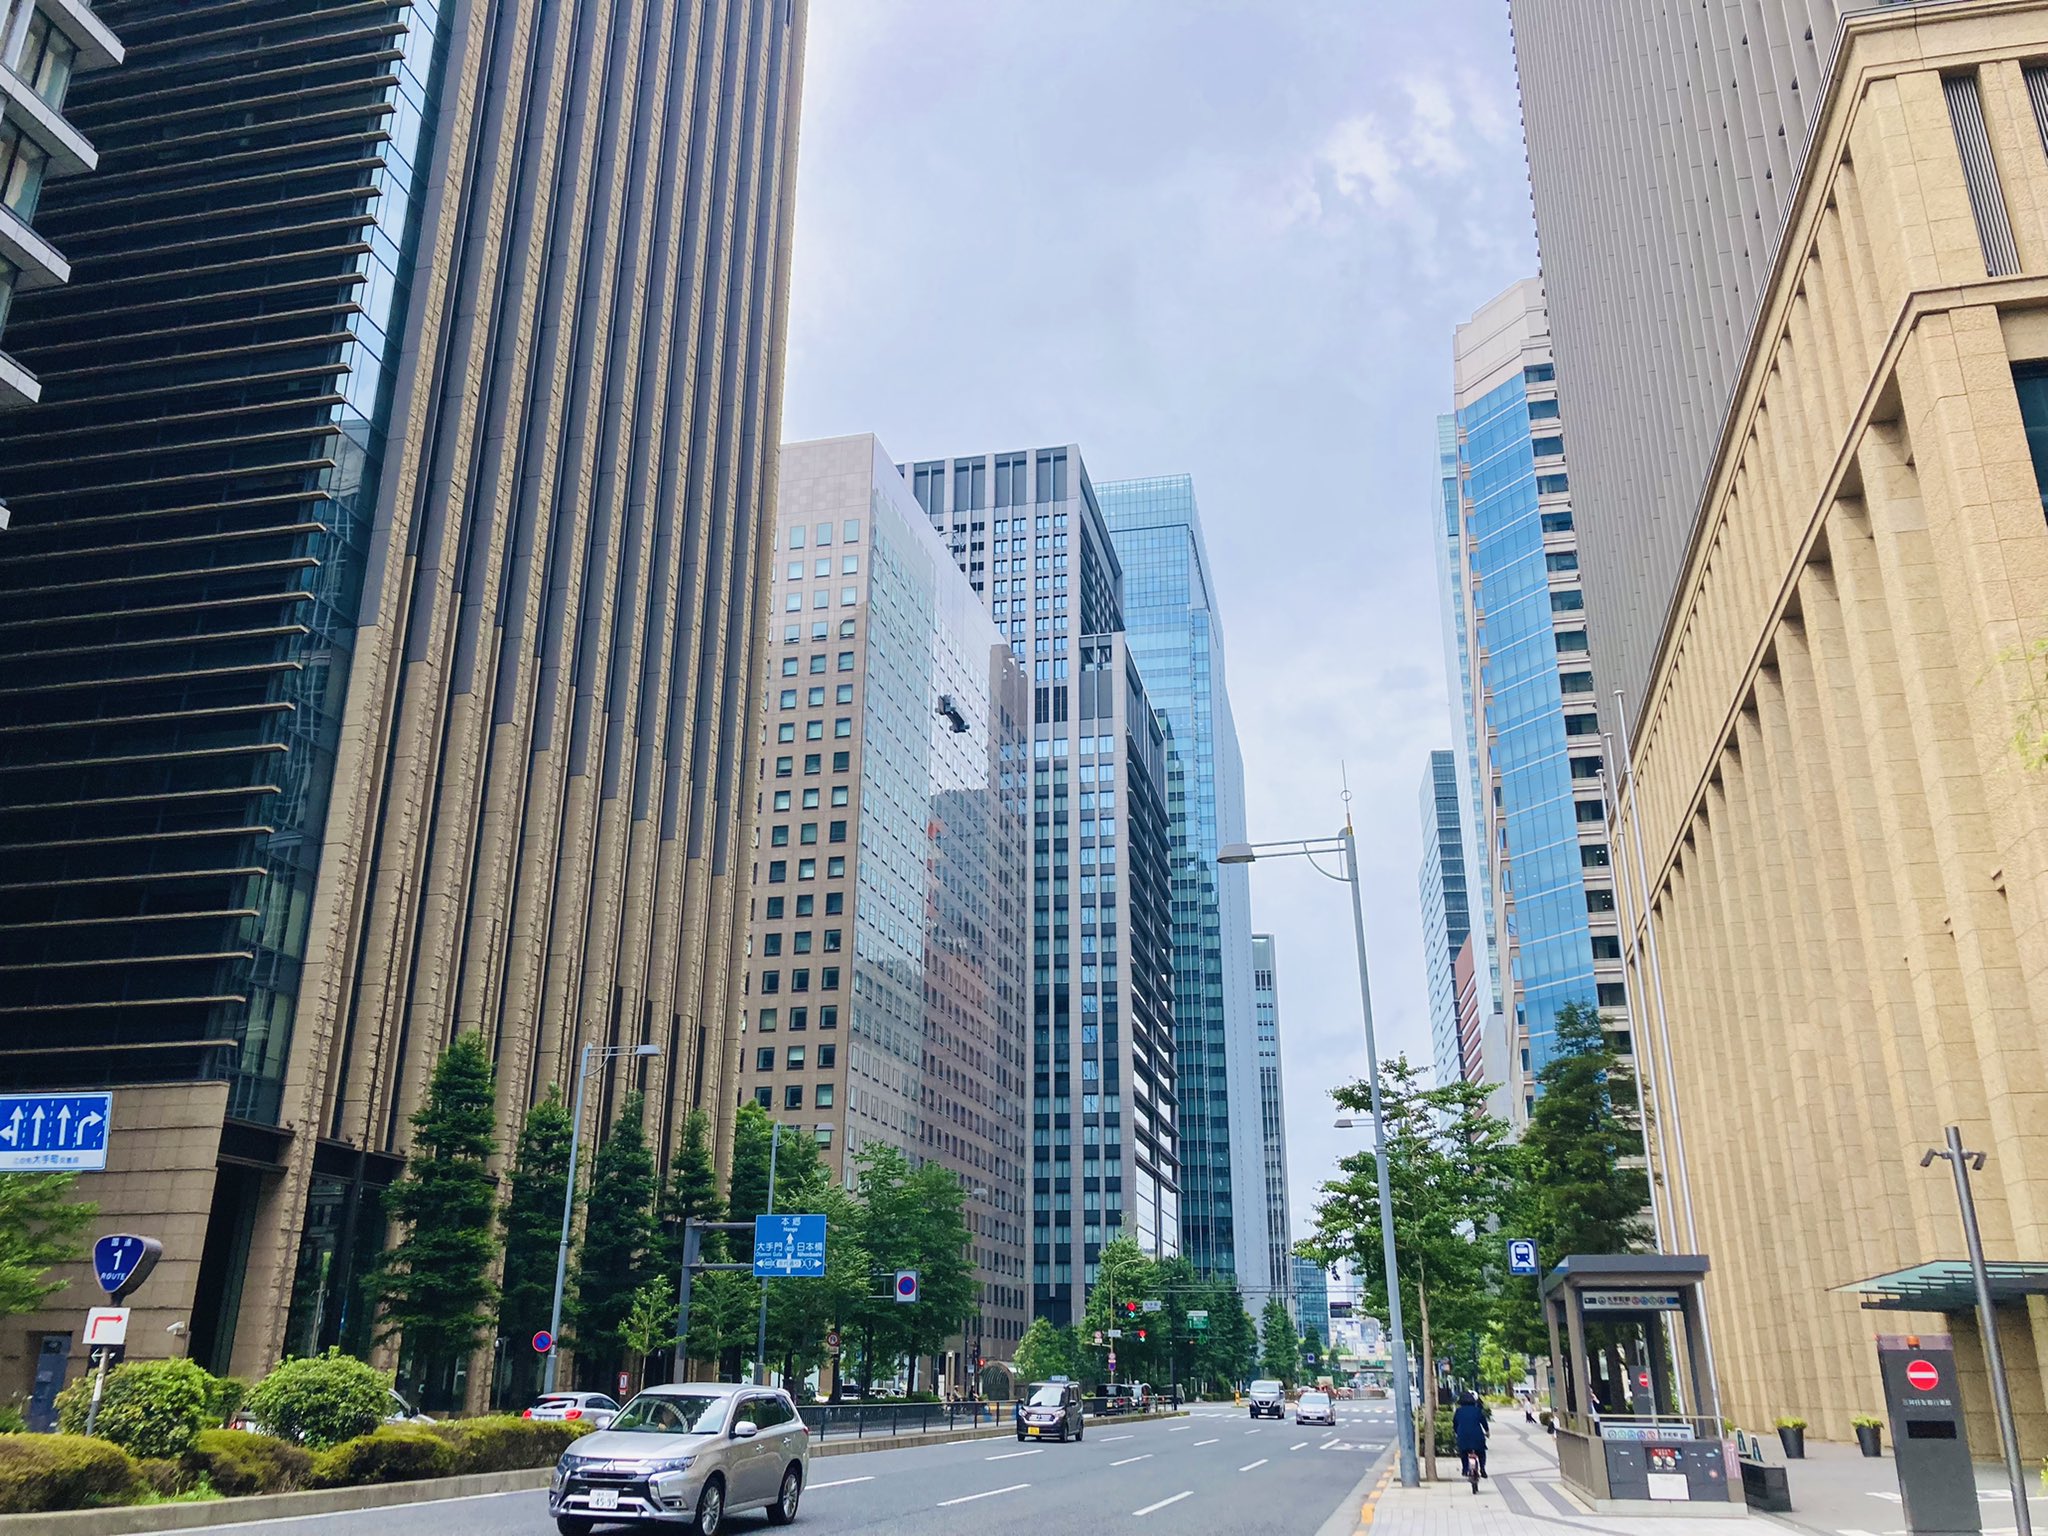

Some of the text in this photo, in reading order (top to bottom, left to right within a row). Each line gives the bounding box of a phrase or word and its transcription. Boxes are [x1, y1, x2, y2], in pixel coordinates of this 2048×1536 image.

[756, 1242, 783, 1252] 大手門
[797, 1242, 823, 1252] 日本橋
[113, 1249, 123, 1270] 1
[100, 1272, 126, 1281] ROUTE
